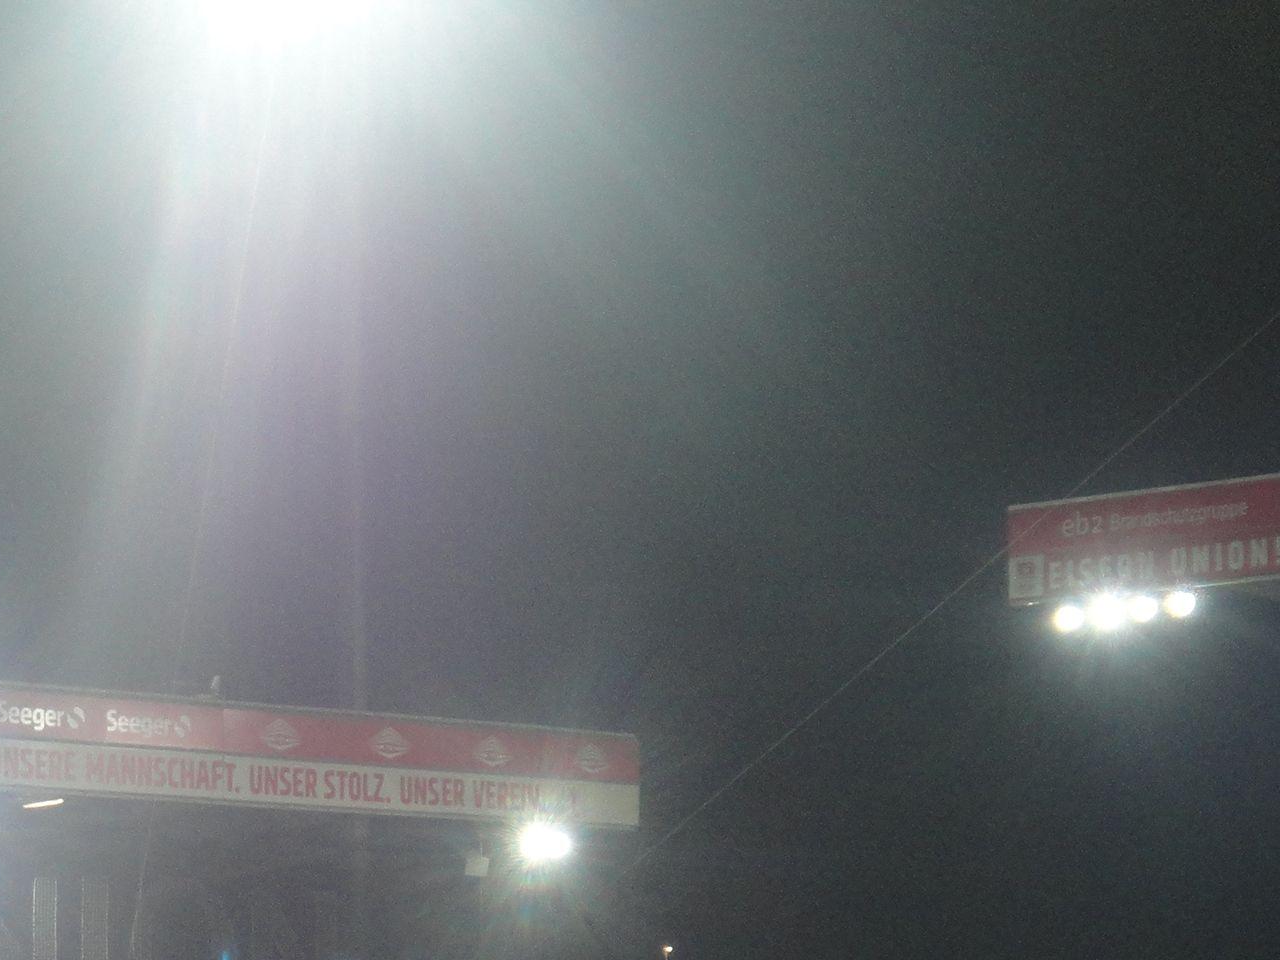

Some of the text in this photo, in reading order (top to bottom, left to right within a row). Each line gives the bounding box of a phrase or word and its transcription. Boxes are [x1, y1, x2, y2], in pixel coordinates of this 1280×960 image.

[1169, 536, 1280, 577] UNION
[106, 708, 173, 738] Seeger
[84, 752, 240, 795] MANNSCHAFT.
[249, 766, 317, 799] UNSER
[323, 770, 391, 804] STOLZ.
[399, 775, 466, 808] UNSER
